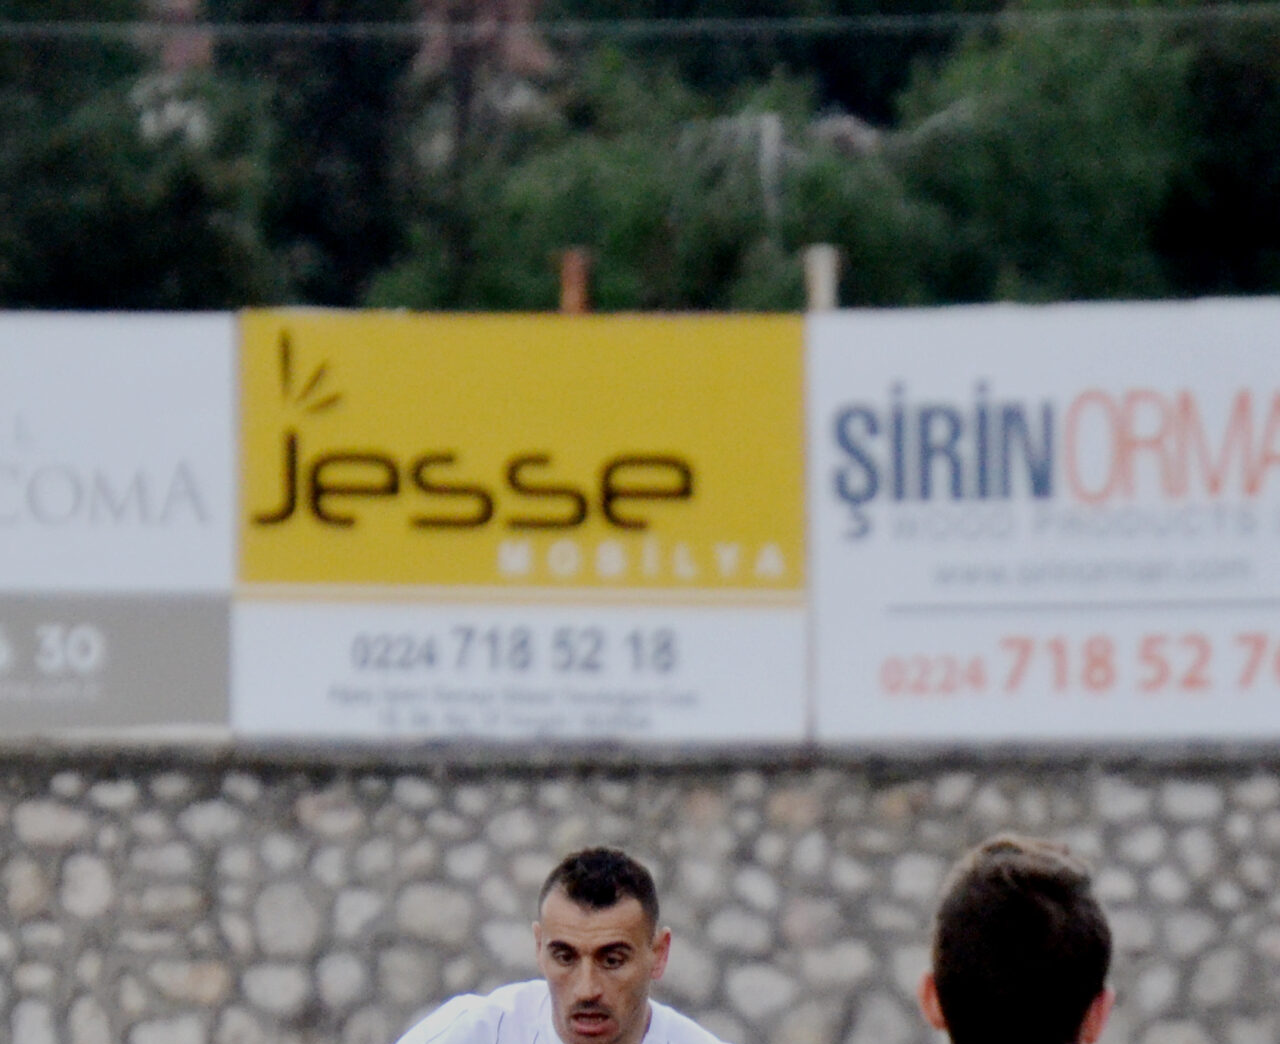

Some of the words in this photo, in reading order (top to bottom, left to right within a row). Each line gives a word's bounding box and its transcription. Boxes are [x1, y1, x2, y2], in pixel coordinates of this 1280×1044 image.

[496, 535, 787, 580] MOBİLYA
[35, 625, 105, 672] 30
[350, 634, 437, 671] 0224
[452, 626, 533, 672] 718
[553, 628, 604, 672] 52
[626, 627, 678, 672] 18
[880, 656, 988, 694] 0224
[1000, 634, 1116, 693] 718
[1138, 634, 1214, 692] 52
[1234, 632, 1280, 692] 7
